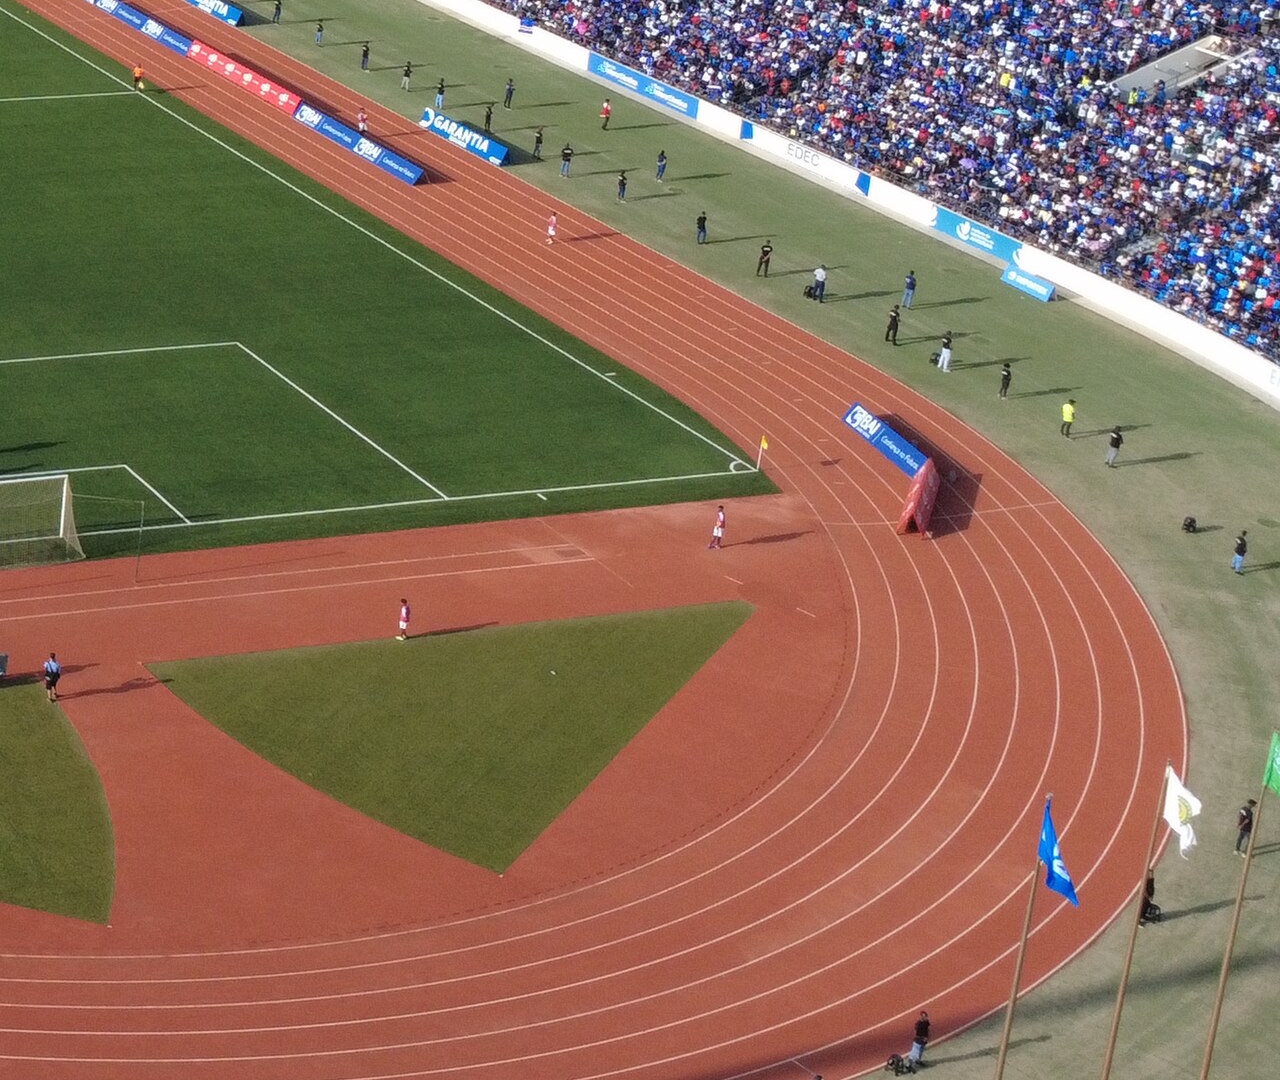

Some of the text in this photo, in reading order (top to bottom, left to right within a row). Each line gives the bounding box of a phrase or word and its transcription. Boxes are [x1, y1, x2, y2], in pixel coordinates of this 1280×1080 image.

[433, 115, 489, 153] GARANTIA
[367, 143, 382, 159] BAI
[787, 143, 819, 167] EDEC
[861, 411, 881, 436] BAI
